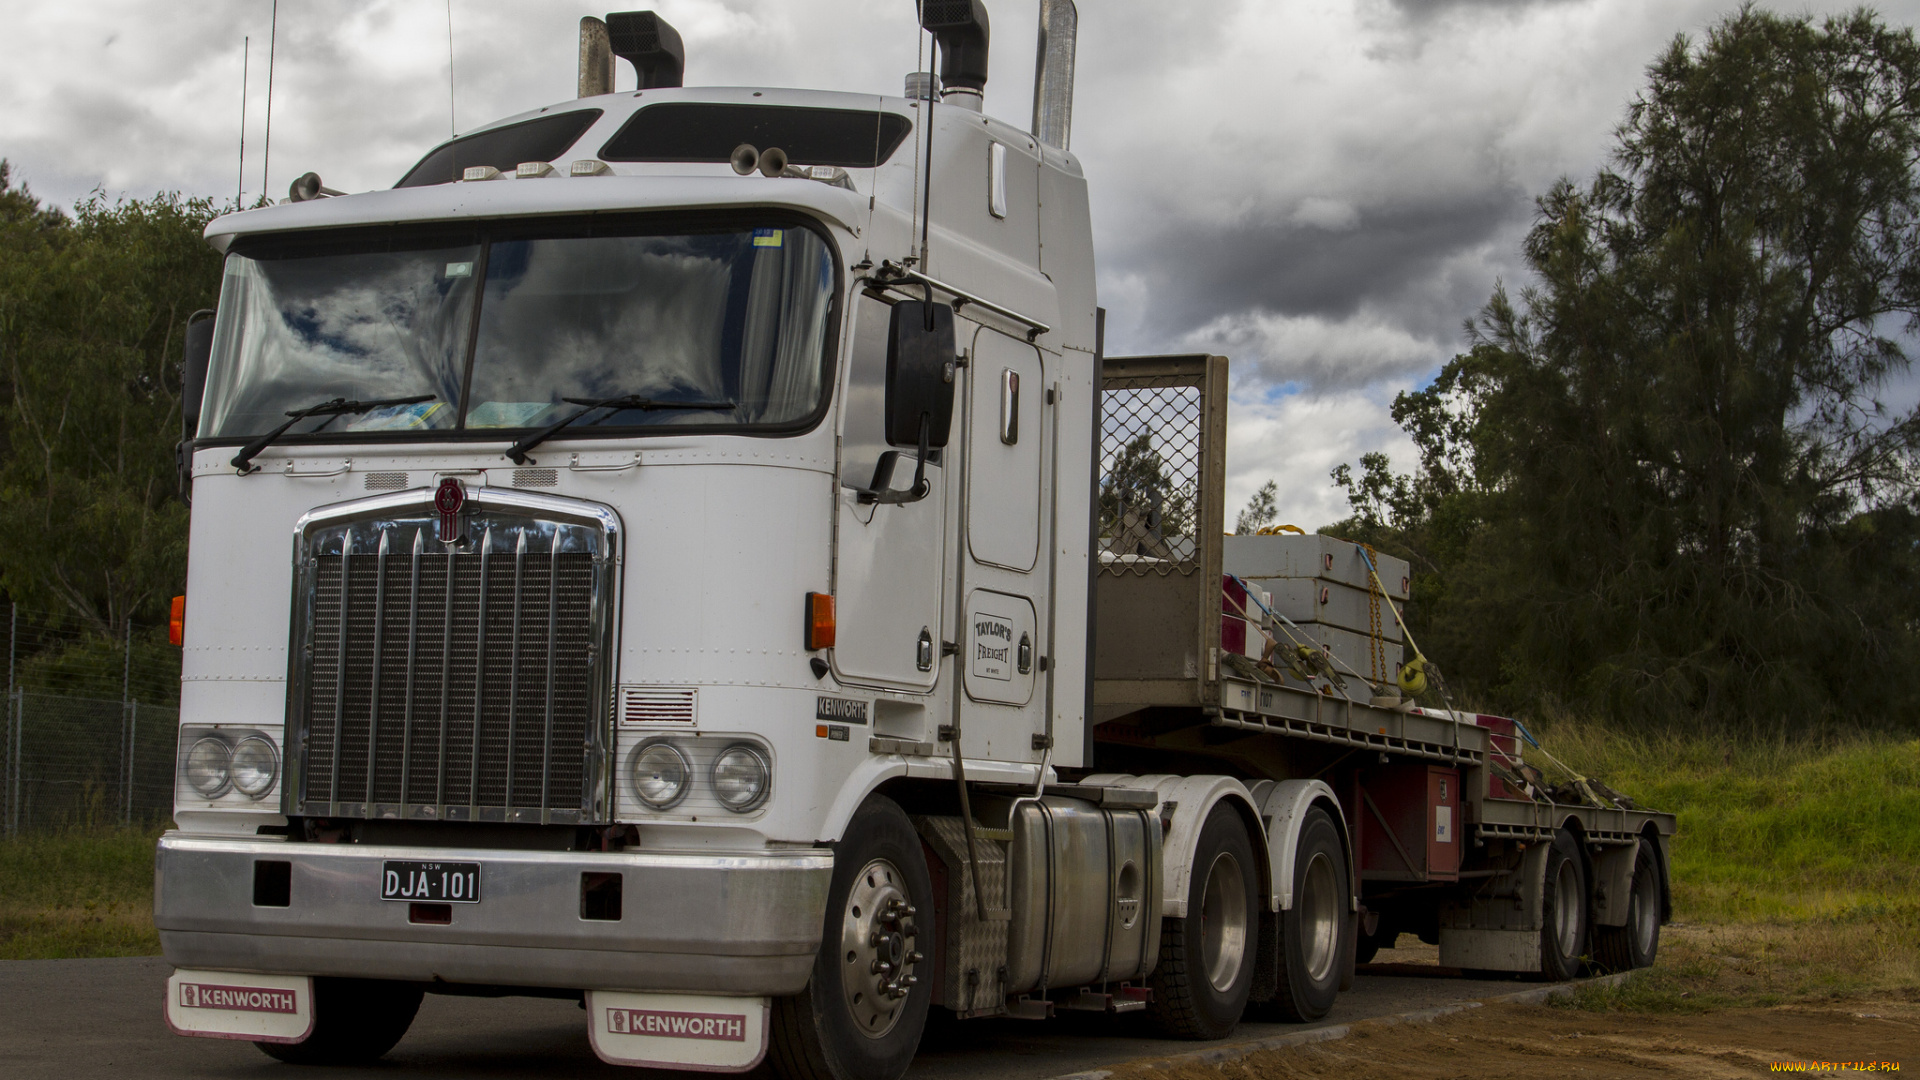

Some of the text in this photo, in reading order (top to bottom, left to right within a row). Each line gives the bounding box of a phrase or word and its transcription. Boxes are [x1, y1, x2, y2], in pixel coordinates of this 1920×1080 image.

[976, 621, 1012, 642] TAYLOR'S
[977, 642, 1009, 664] FREIGHT
[818, 697, 868, 719] KENWORTH
[421, 863, 442, 871] NSW
[201, 988, 294, 1010] KENWORTH
[632, 1014, 742, 1036] KENWORTH
